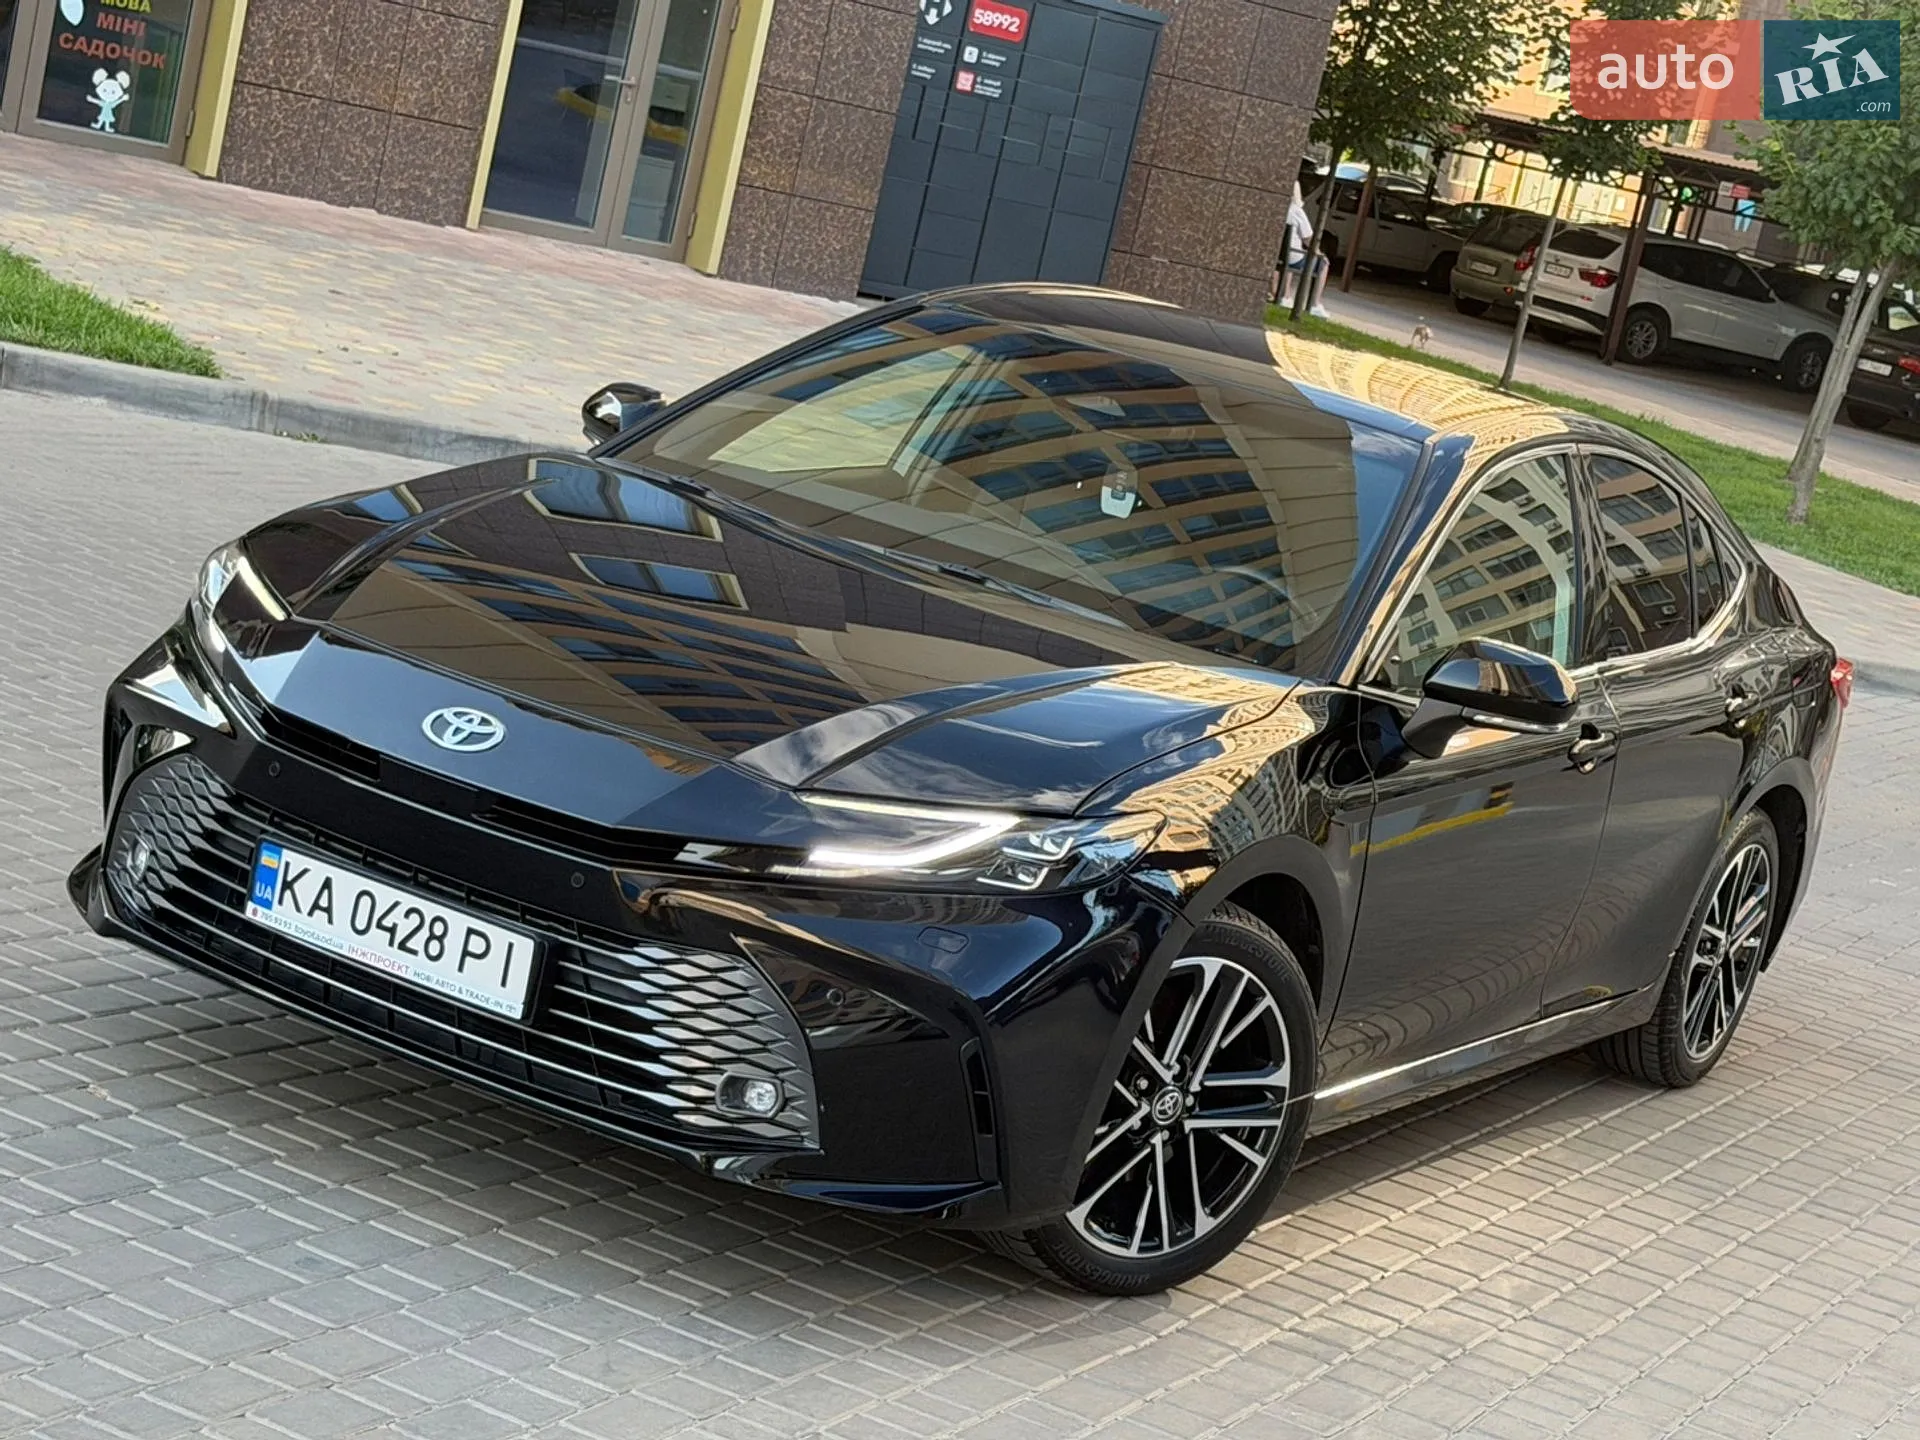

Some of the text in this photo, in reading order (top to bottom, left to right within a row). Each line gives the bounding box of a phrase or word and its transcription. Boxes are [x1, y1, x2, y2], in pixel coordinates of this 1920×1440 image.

[96, 11, 147, 37] МІНІ
[972, 8, 1022, 34] 58992
[58, 32, 167, 69] САДОЧОК
[255, 881, 273, 902] UA
[278, 860, 515, 989] KA 0428 PI
[347, 944, 410, 975] ІНЖПРОЕКТ
[456, 986, 464, 995] &
[465, 988, 504, 1009] TRADE-IN
